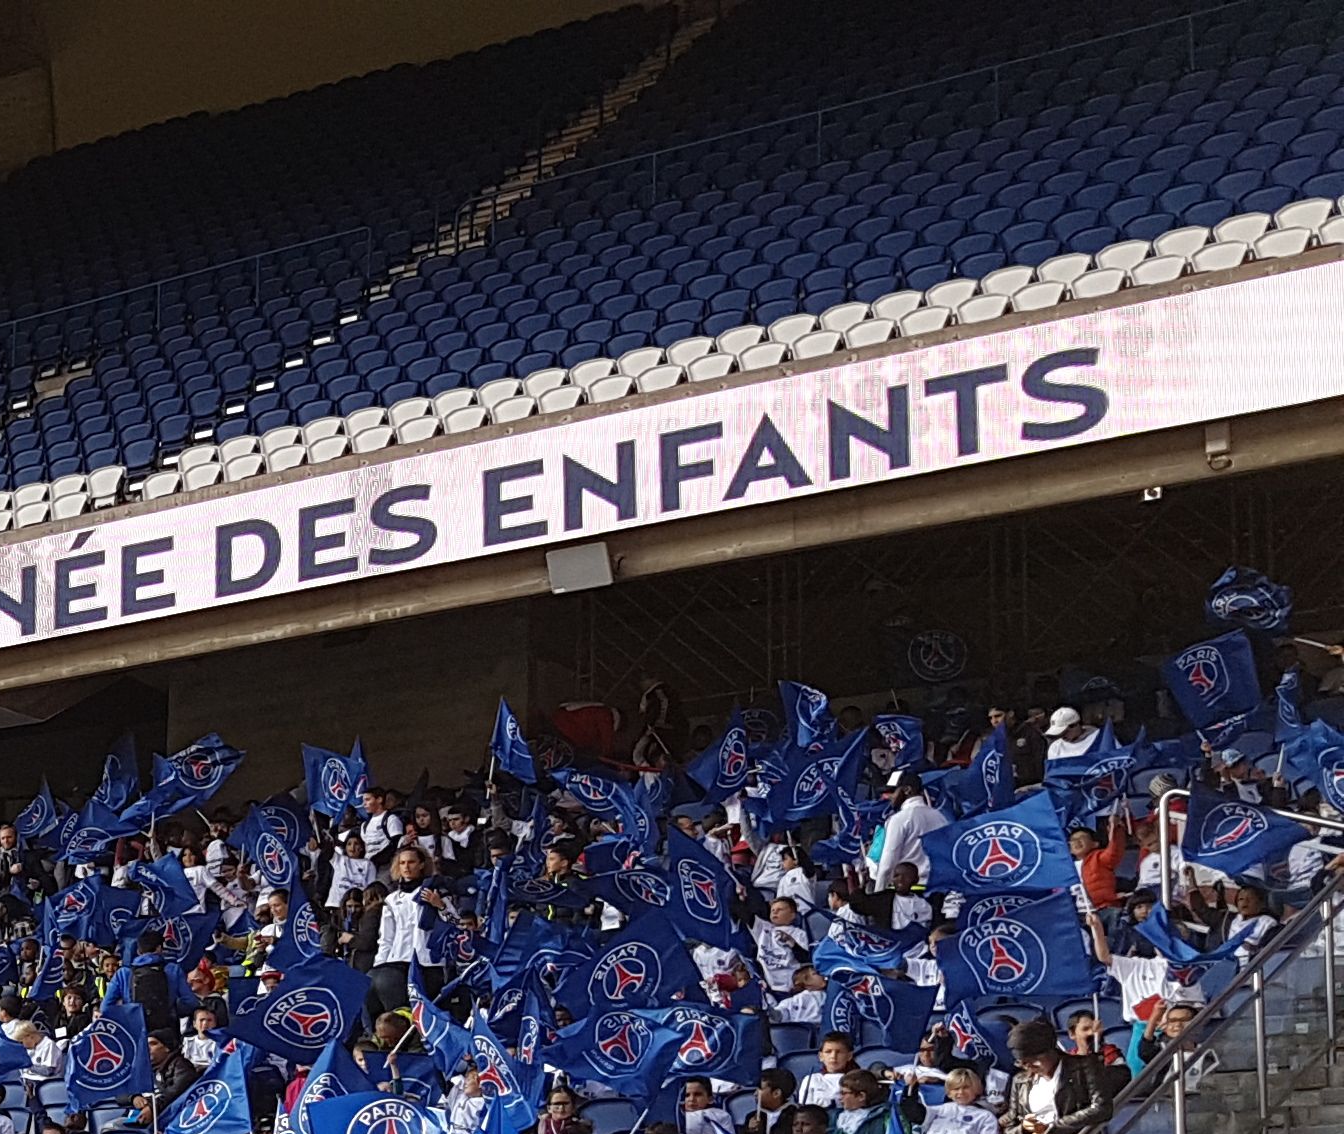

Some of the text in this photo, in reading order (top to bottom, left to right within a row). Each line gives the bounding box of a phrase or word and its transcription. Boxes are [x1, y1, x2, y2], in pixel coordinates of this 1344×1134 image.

[214, 483, 439, 600] DES
[483, 346, 1112, 547] ENFANTS
[268, 991, 307, 1026] PARIS
[359, 1102, 415, 1126] PARIS
